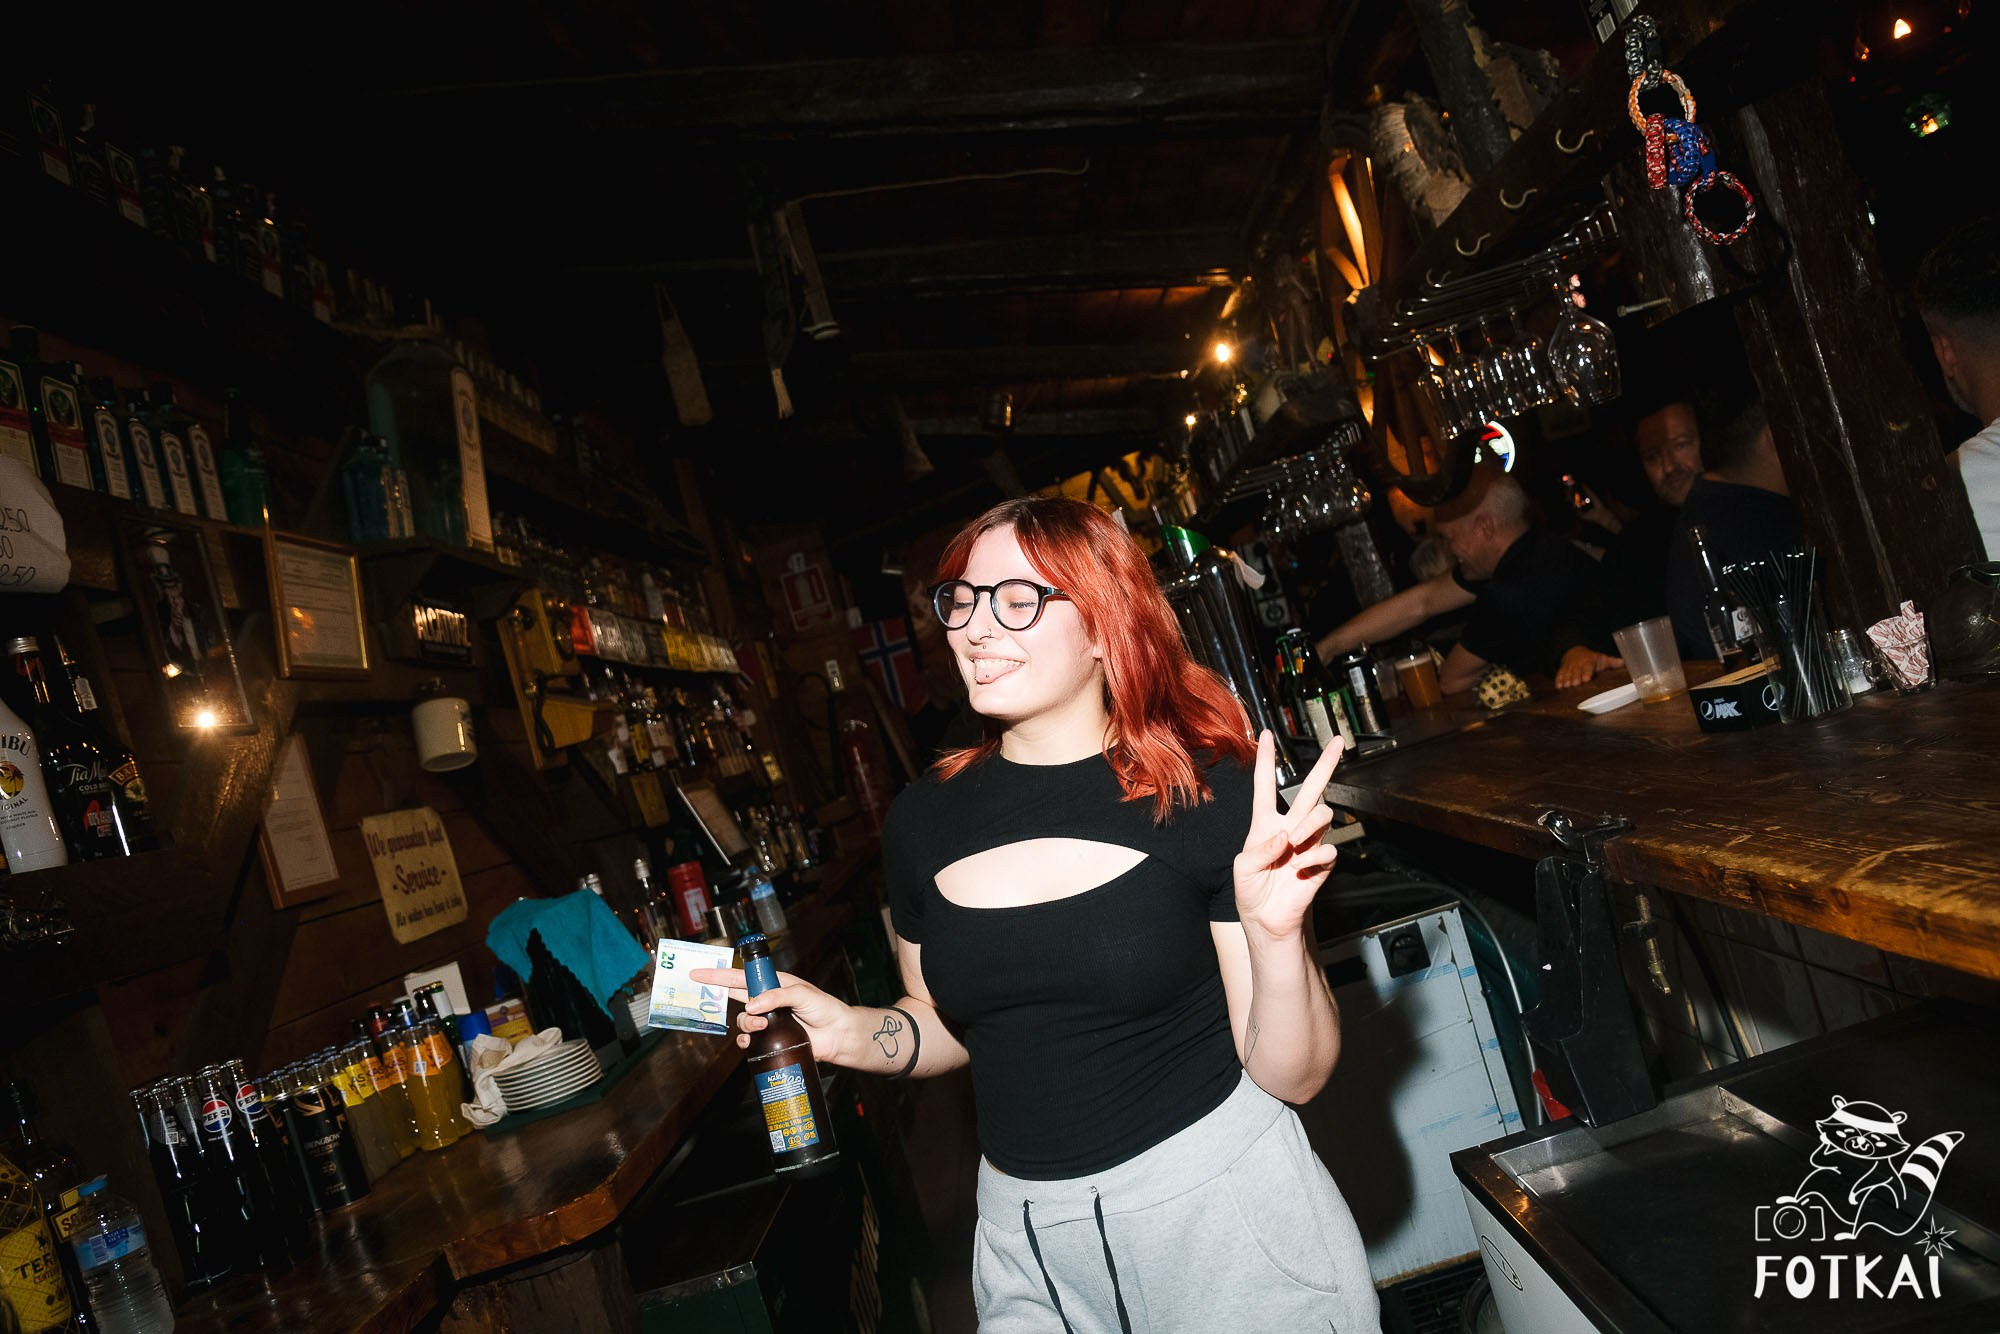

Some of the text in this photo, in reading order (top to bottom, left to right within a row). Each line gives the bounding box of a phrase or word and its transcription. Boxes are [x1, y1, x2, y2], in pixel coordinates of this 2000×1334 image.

[395, 862, 442, 894] Service
[661, 951, 676, 970] 20
[699, 985, 725, 1014] 20
[203, 1109, 230, 1122] PEPSI
